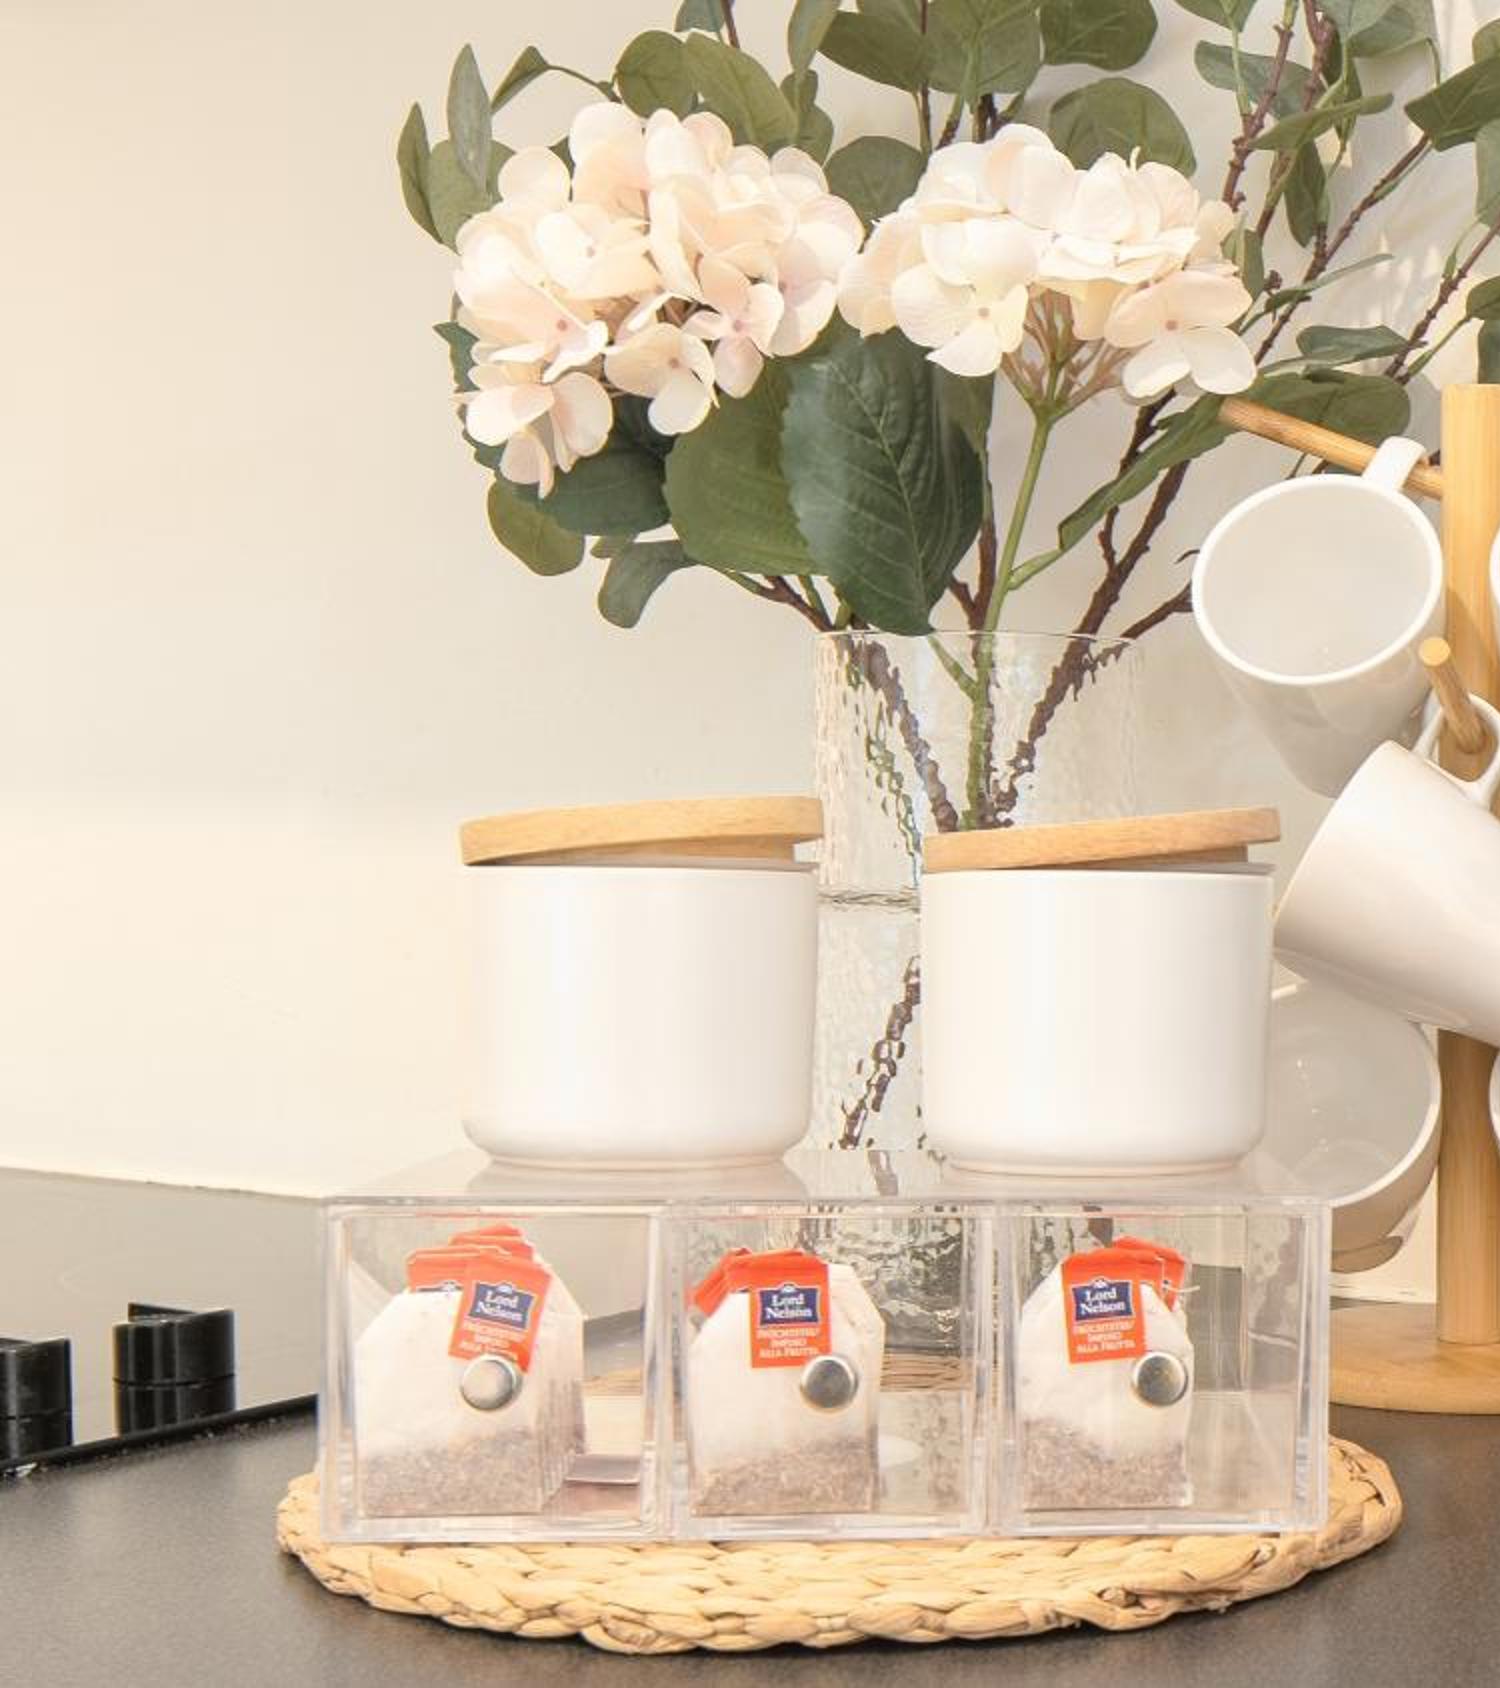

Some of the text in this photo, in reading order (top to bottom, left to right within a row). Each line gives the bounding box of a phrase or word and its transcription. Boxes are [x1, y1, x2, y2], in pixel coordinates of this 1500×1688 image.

[770, 1293, 805, 1307] Lord
[1086, 1287, 1117, 1301] Lord
[765, 1307, 813, 1319] Nelson
[1080, 1301, 1126, 1315] Nelson
